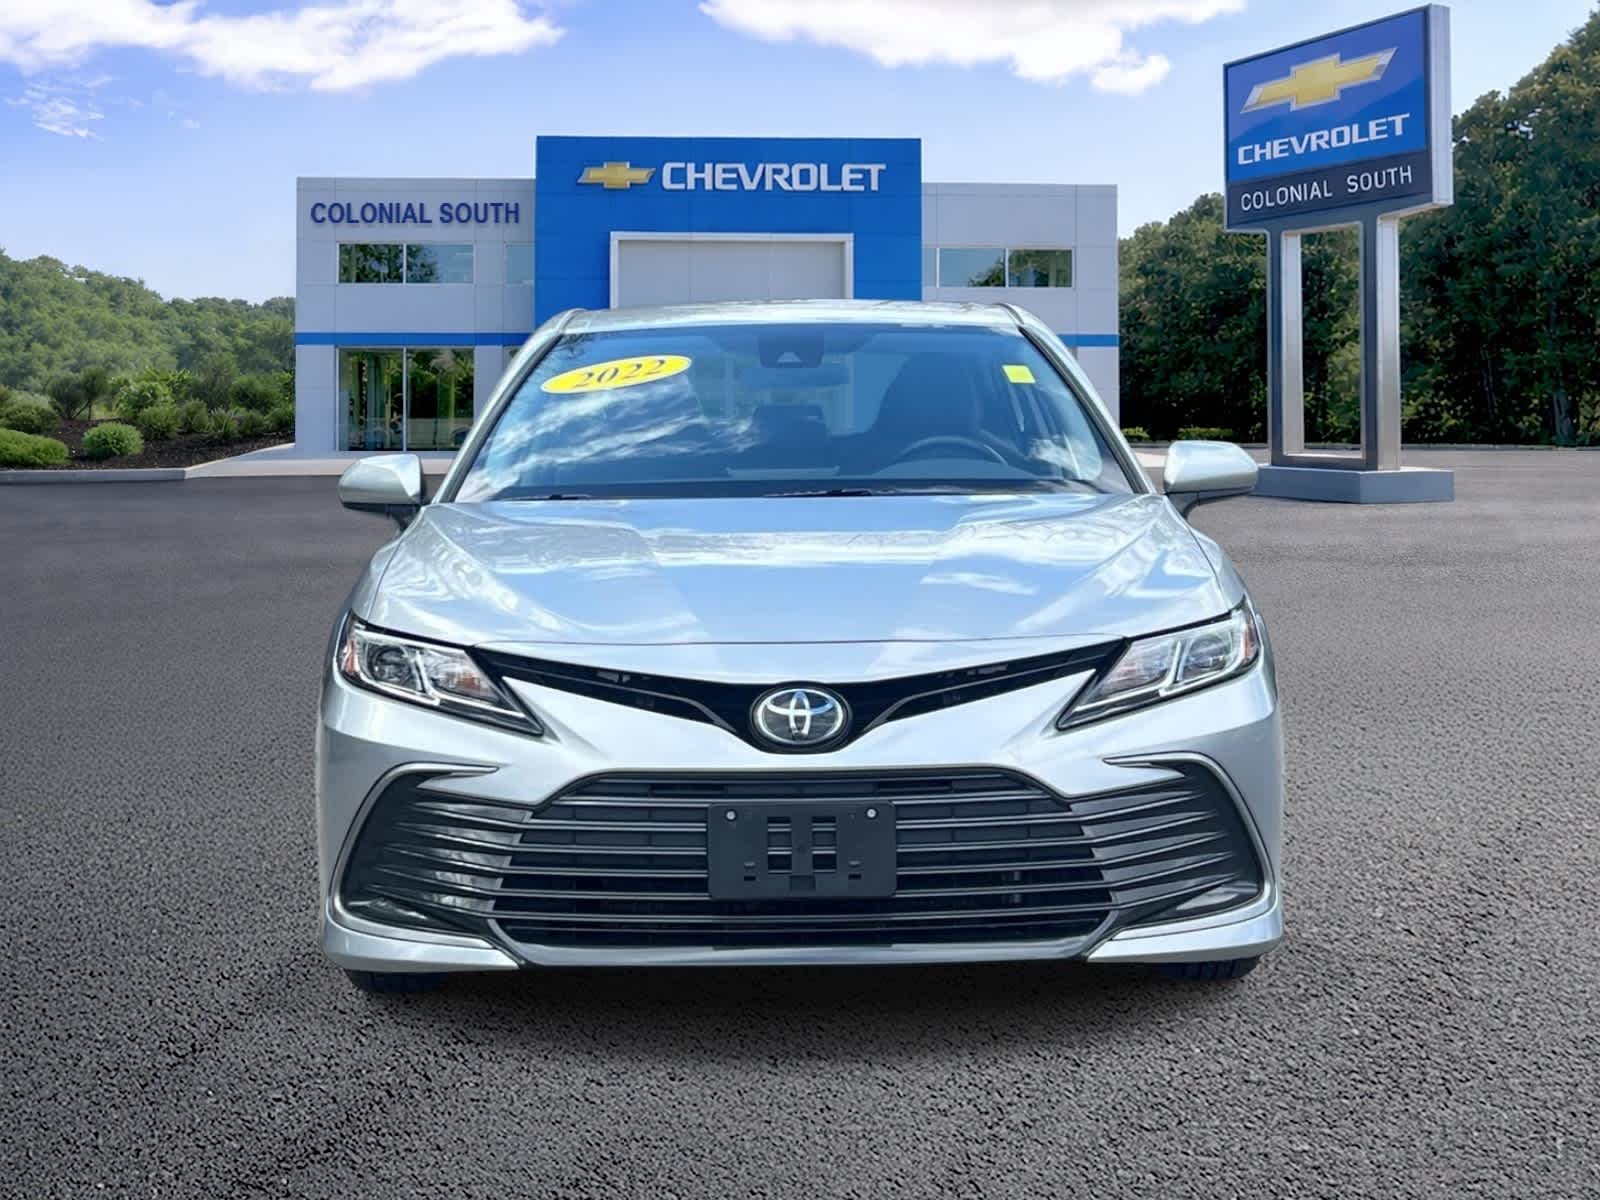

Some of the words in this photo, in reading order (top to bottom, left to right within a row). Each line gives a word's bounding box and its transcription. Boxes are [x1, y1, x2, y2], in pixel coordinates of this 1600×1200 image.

[1237, 113, 1410, 165] CHEVROLET
[661, 162, 886, 192] CHEVROLET
[1240, 180, 1333, 211] COLONIAL
[1346, 165, 1412, 193] SOUTH
[310, 202, 433, 225] COLONIAL
[439, 202, 521, 225] SOUTH
[575, 359, 666, 388] 2022
